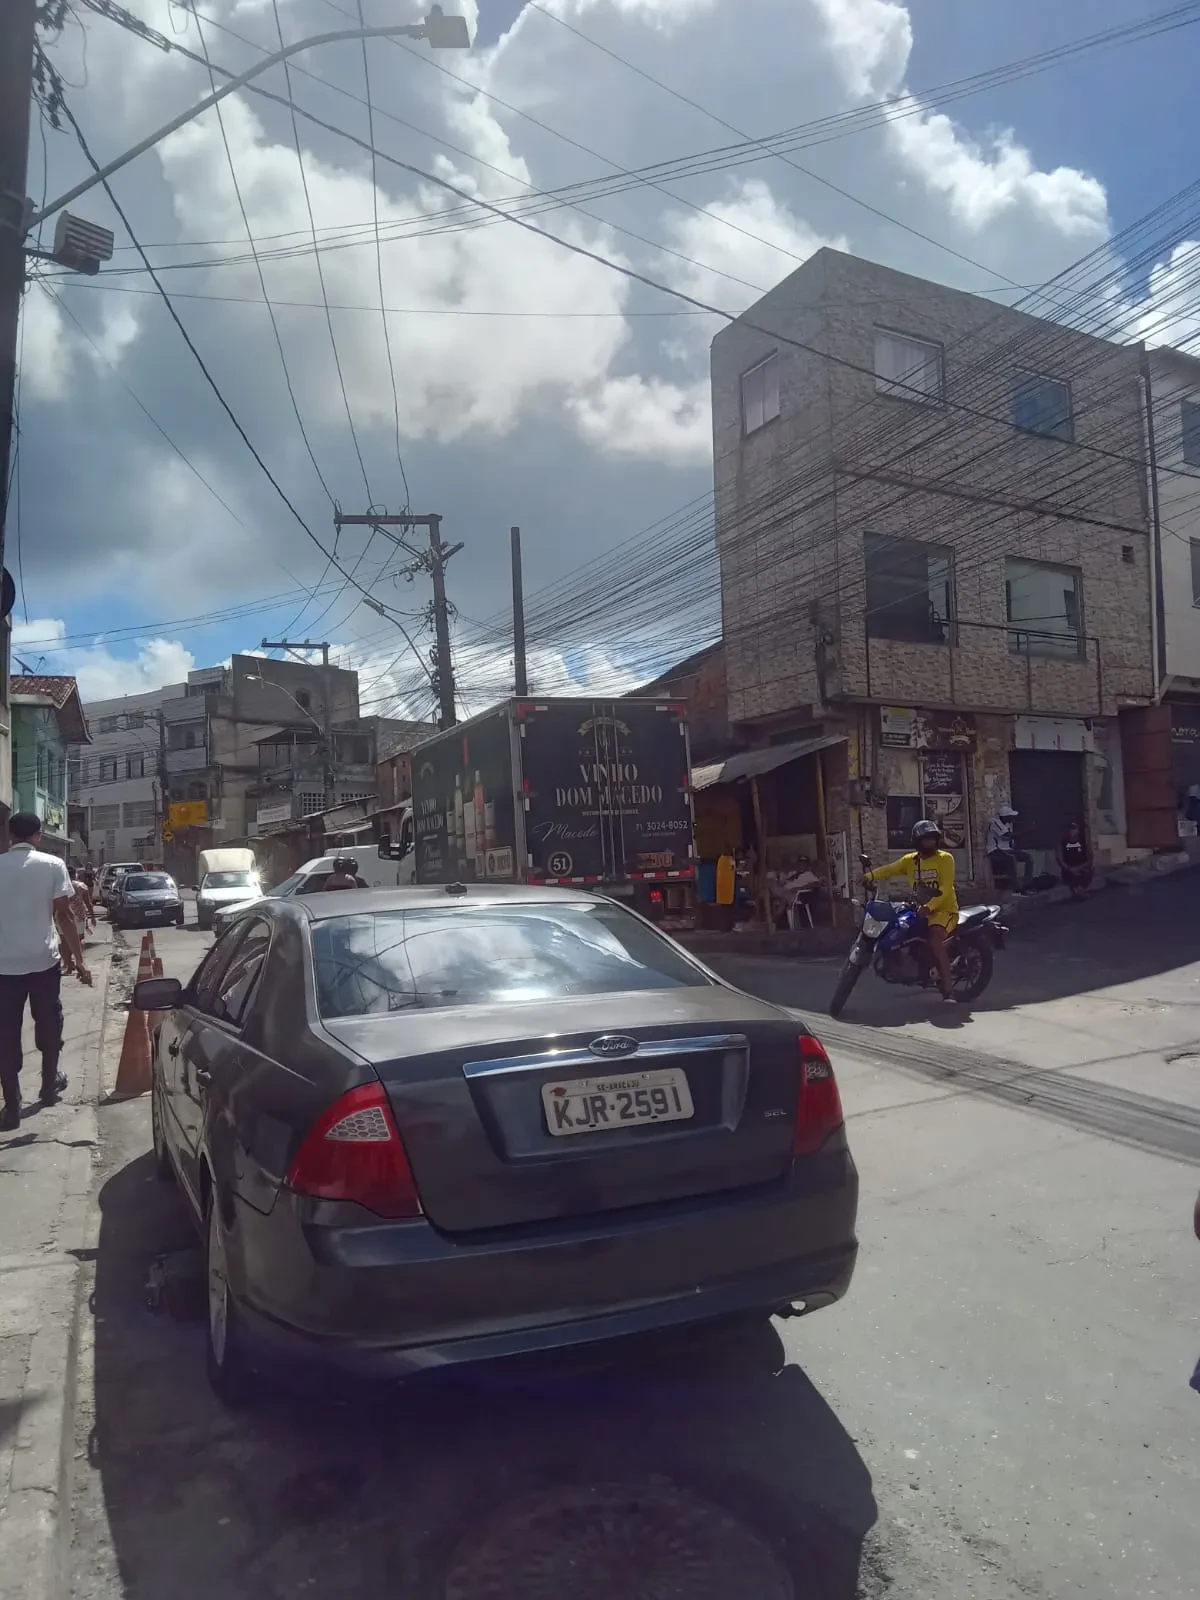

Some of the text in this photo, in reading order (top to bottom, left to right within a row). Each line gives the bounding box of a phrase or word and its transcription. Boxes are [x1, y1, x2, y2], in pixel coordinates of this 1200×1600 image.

[579, 763, 639, 783] VINHO
[555, 786, 593, 807] DOM
[646, 821, 689, 832] 3024-8052
[552, 857, 568, 872] 51
[601, 1041, 631, 1053] Ford
[553, 1086, 683, 1129] KJR-2591
